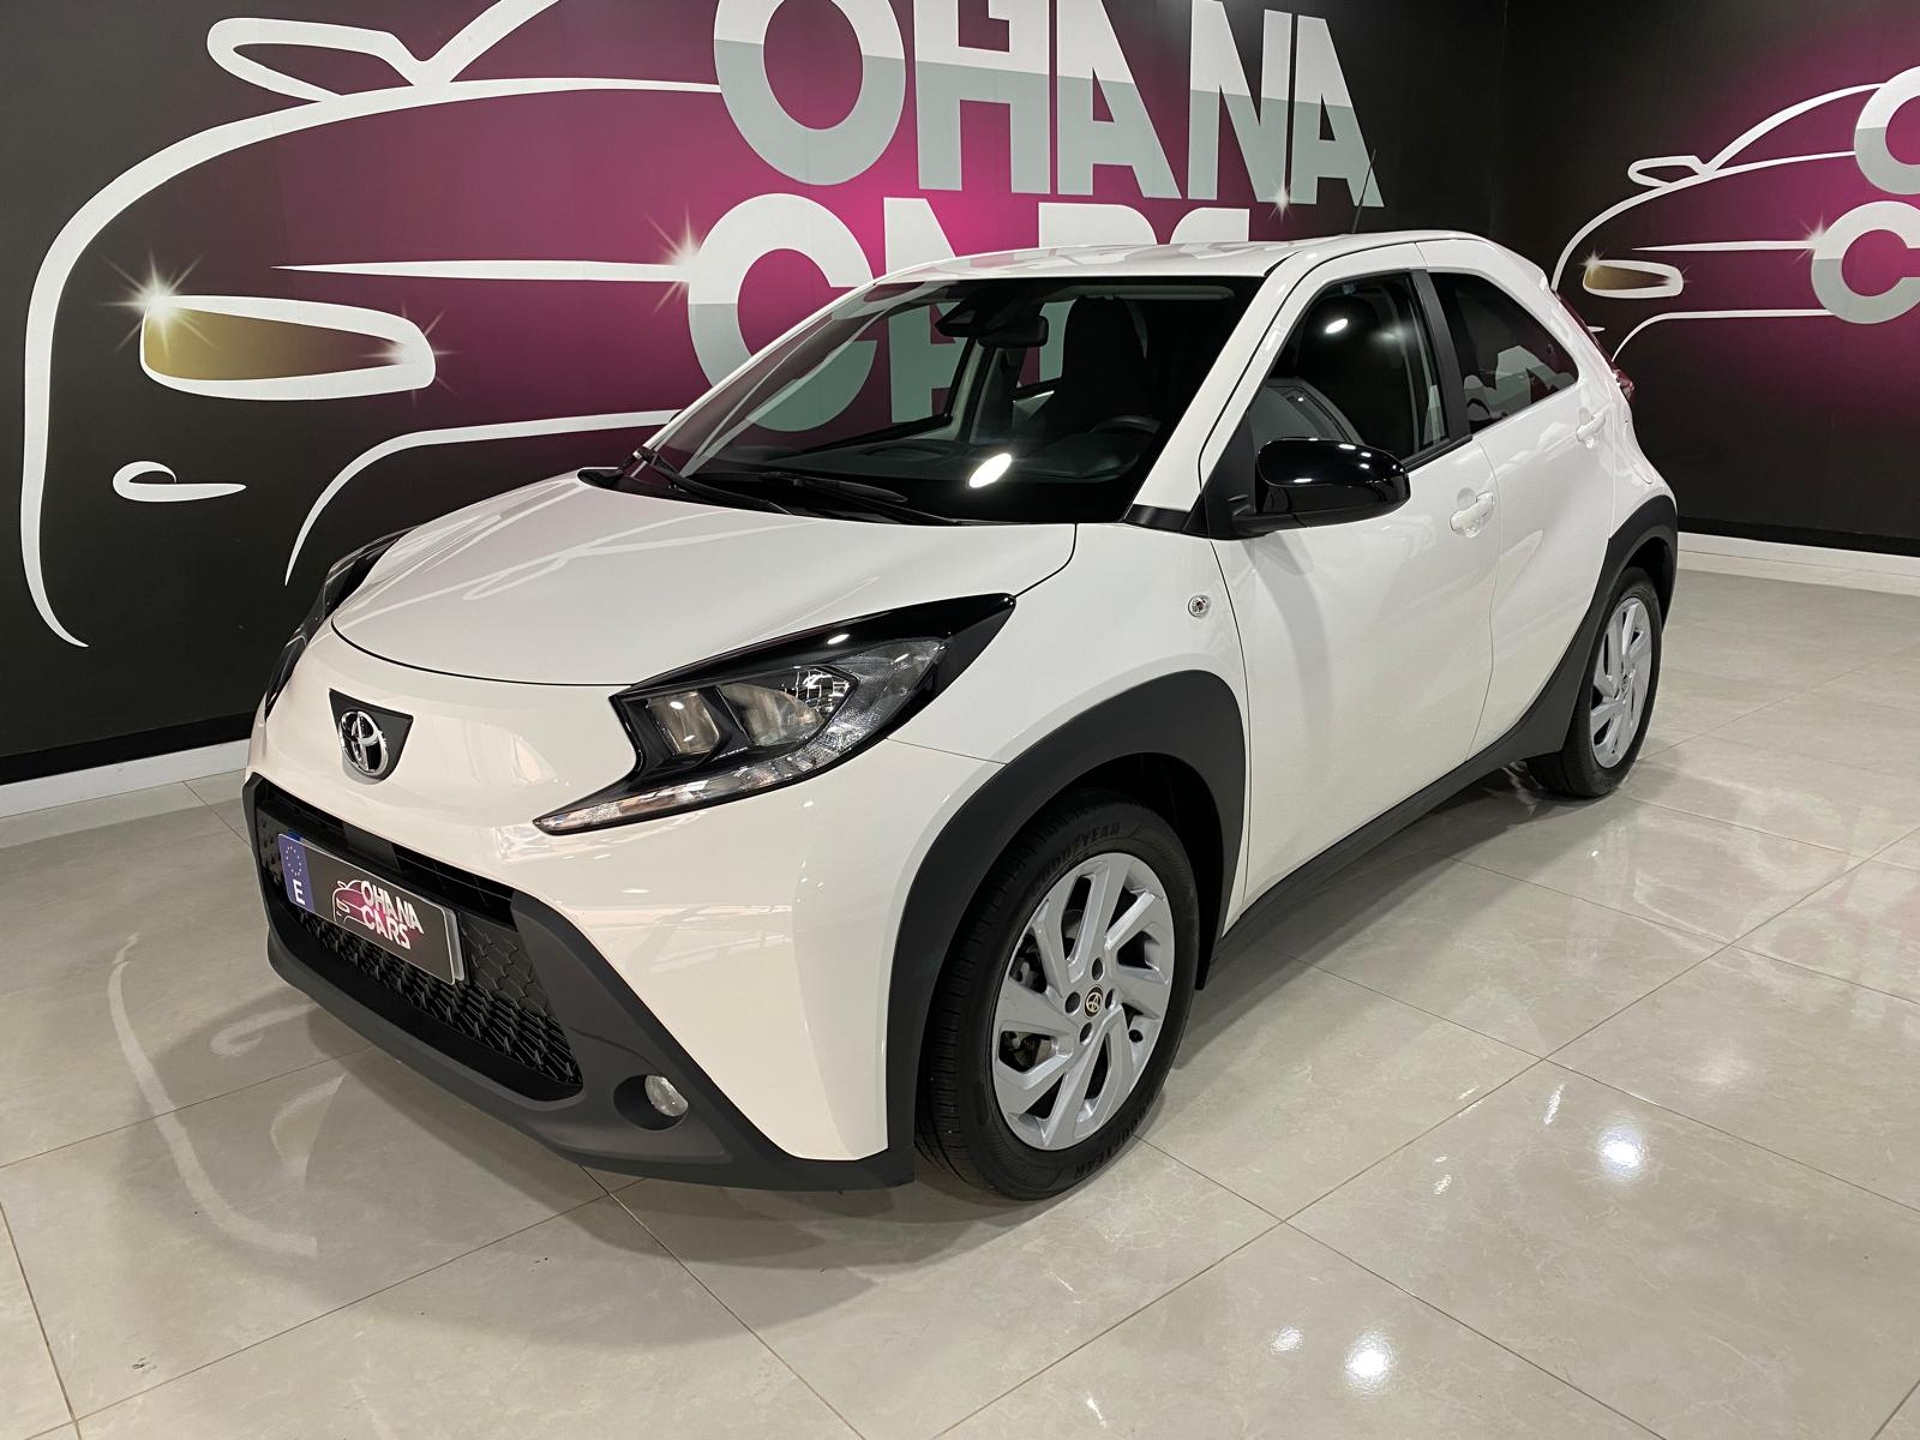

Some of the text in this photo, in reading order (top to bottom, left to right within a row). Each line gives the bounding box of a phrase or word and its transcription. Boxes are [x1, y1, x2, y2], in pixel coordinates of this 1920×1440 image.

[713, 0, 1384, 207] OHANA
[688, 193, 1250, 432] CA
[292, 879, 306, 905] E
[360, 880, 424, 934] OHANA
[361, 906, 411, 949] CARS
